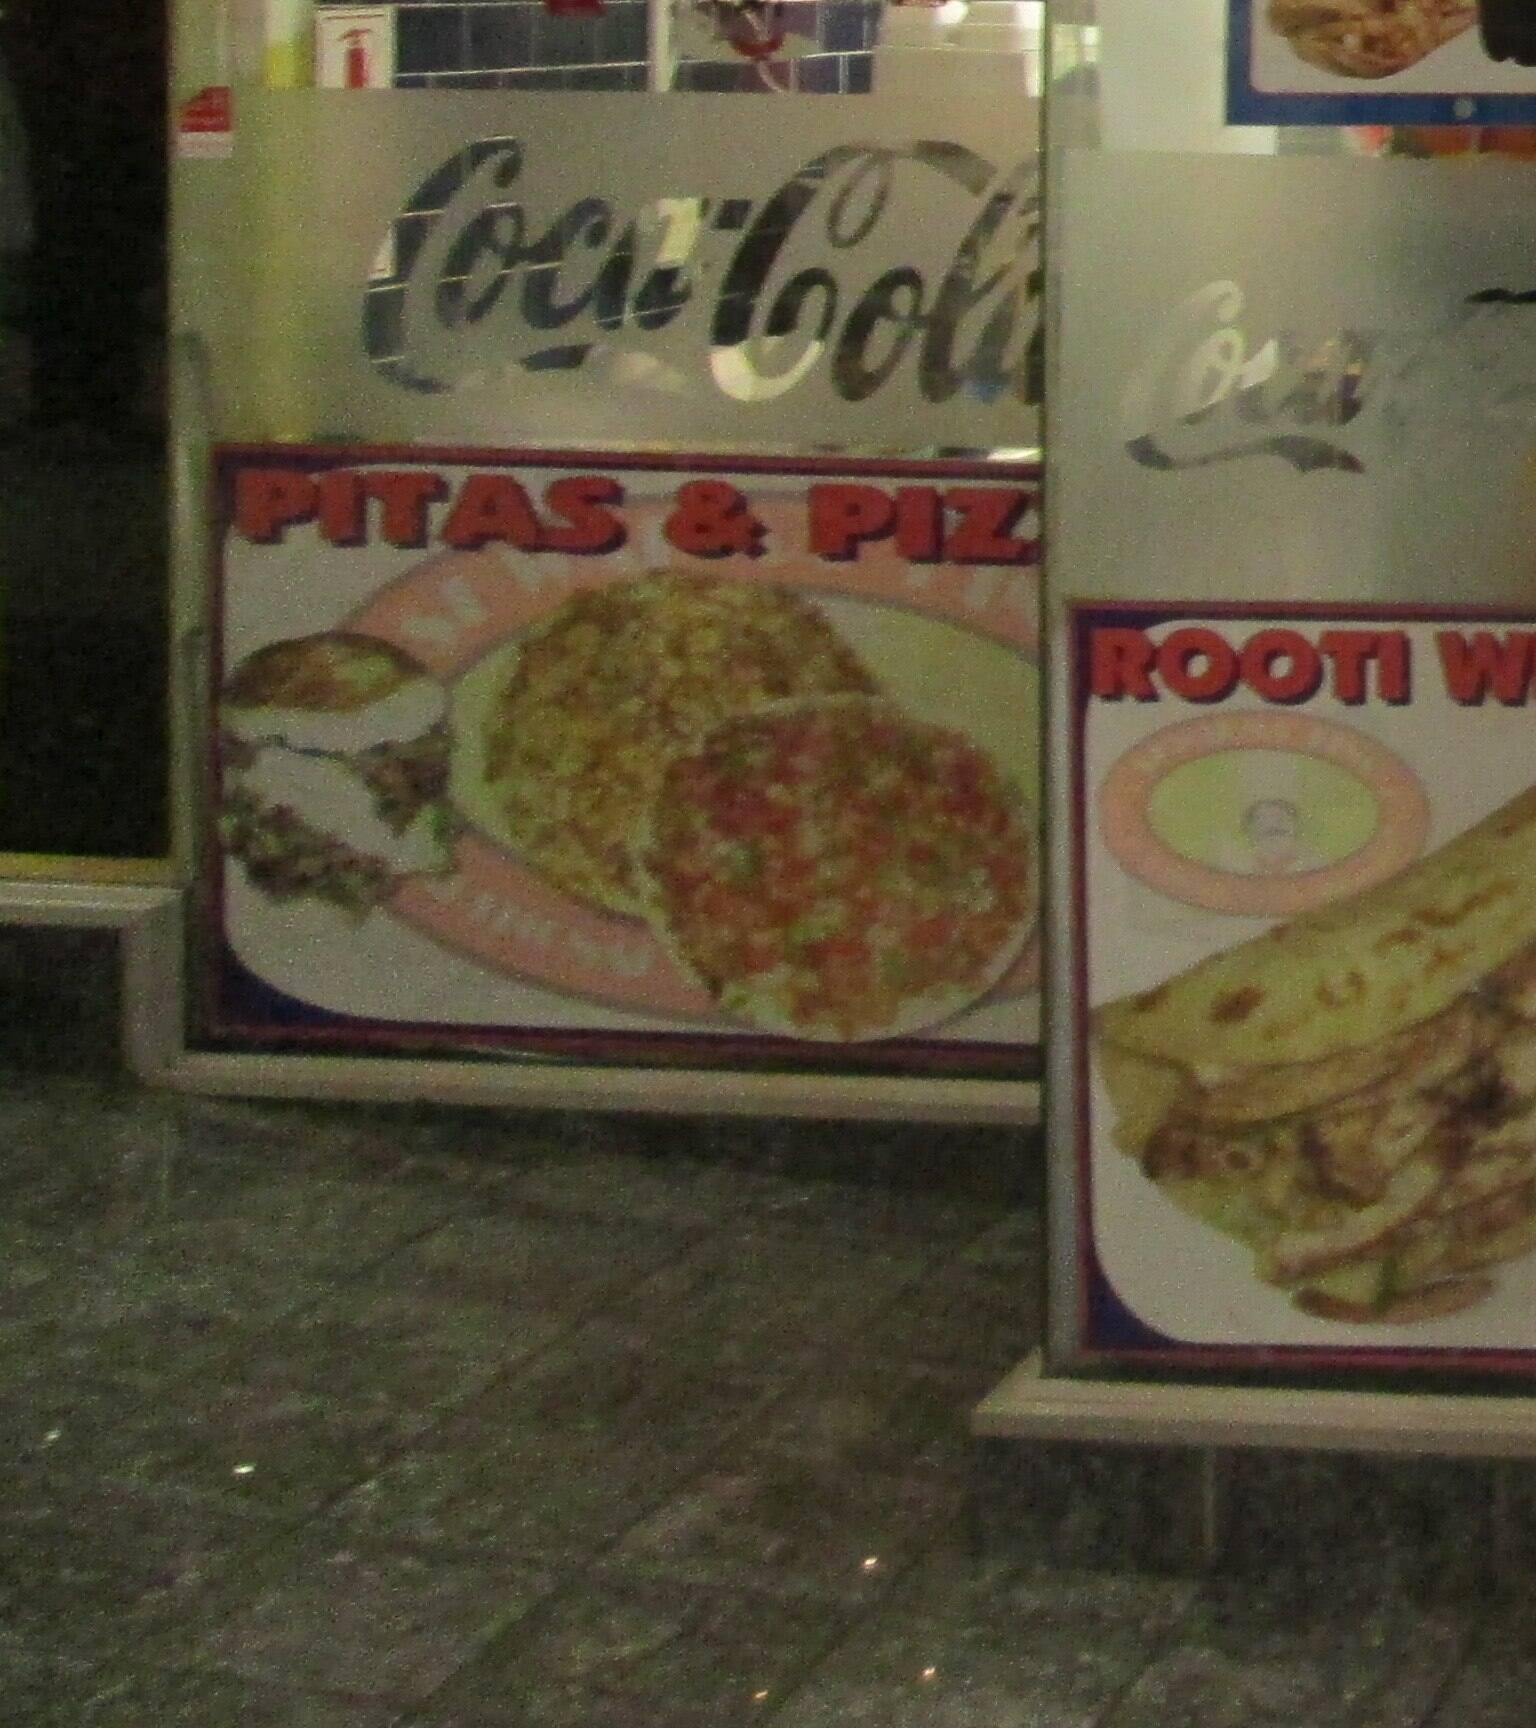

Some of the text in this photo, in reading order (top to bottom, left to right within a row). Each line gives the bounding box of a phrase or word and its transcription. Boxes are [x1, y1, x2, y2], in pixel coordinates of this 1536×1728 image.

[234, 470, 1042, 566] PITAS & PIZ
[1088, 627, 1411, 706] ROOTI
